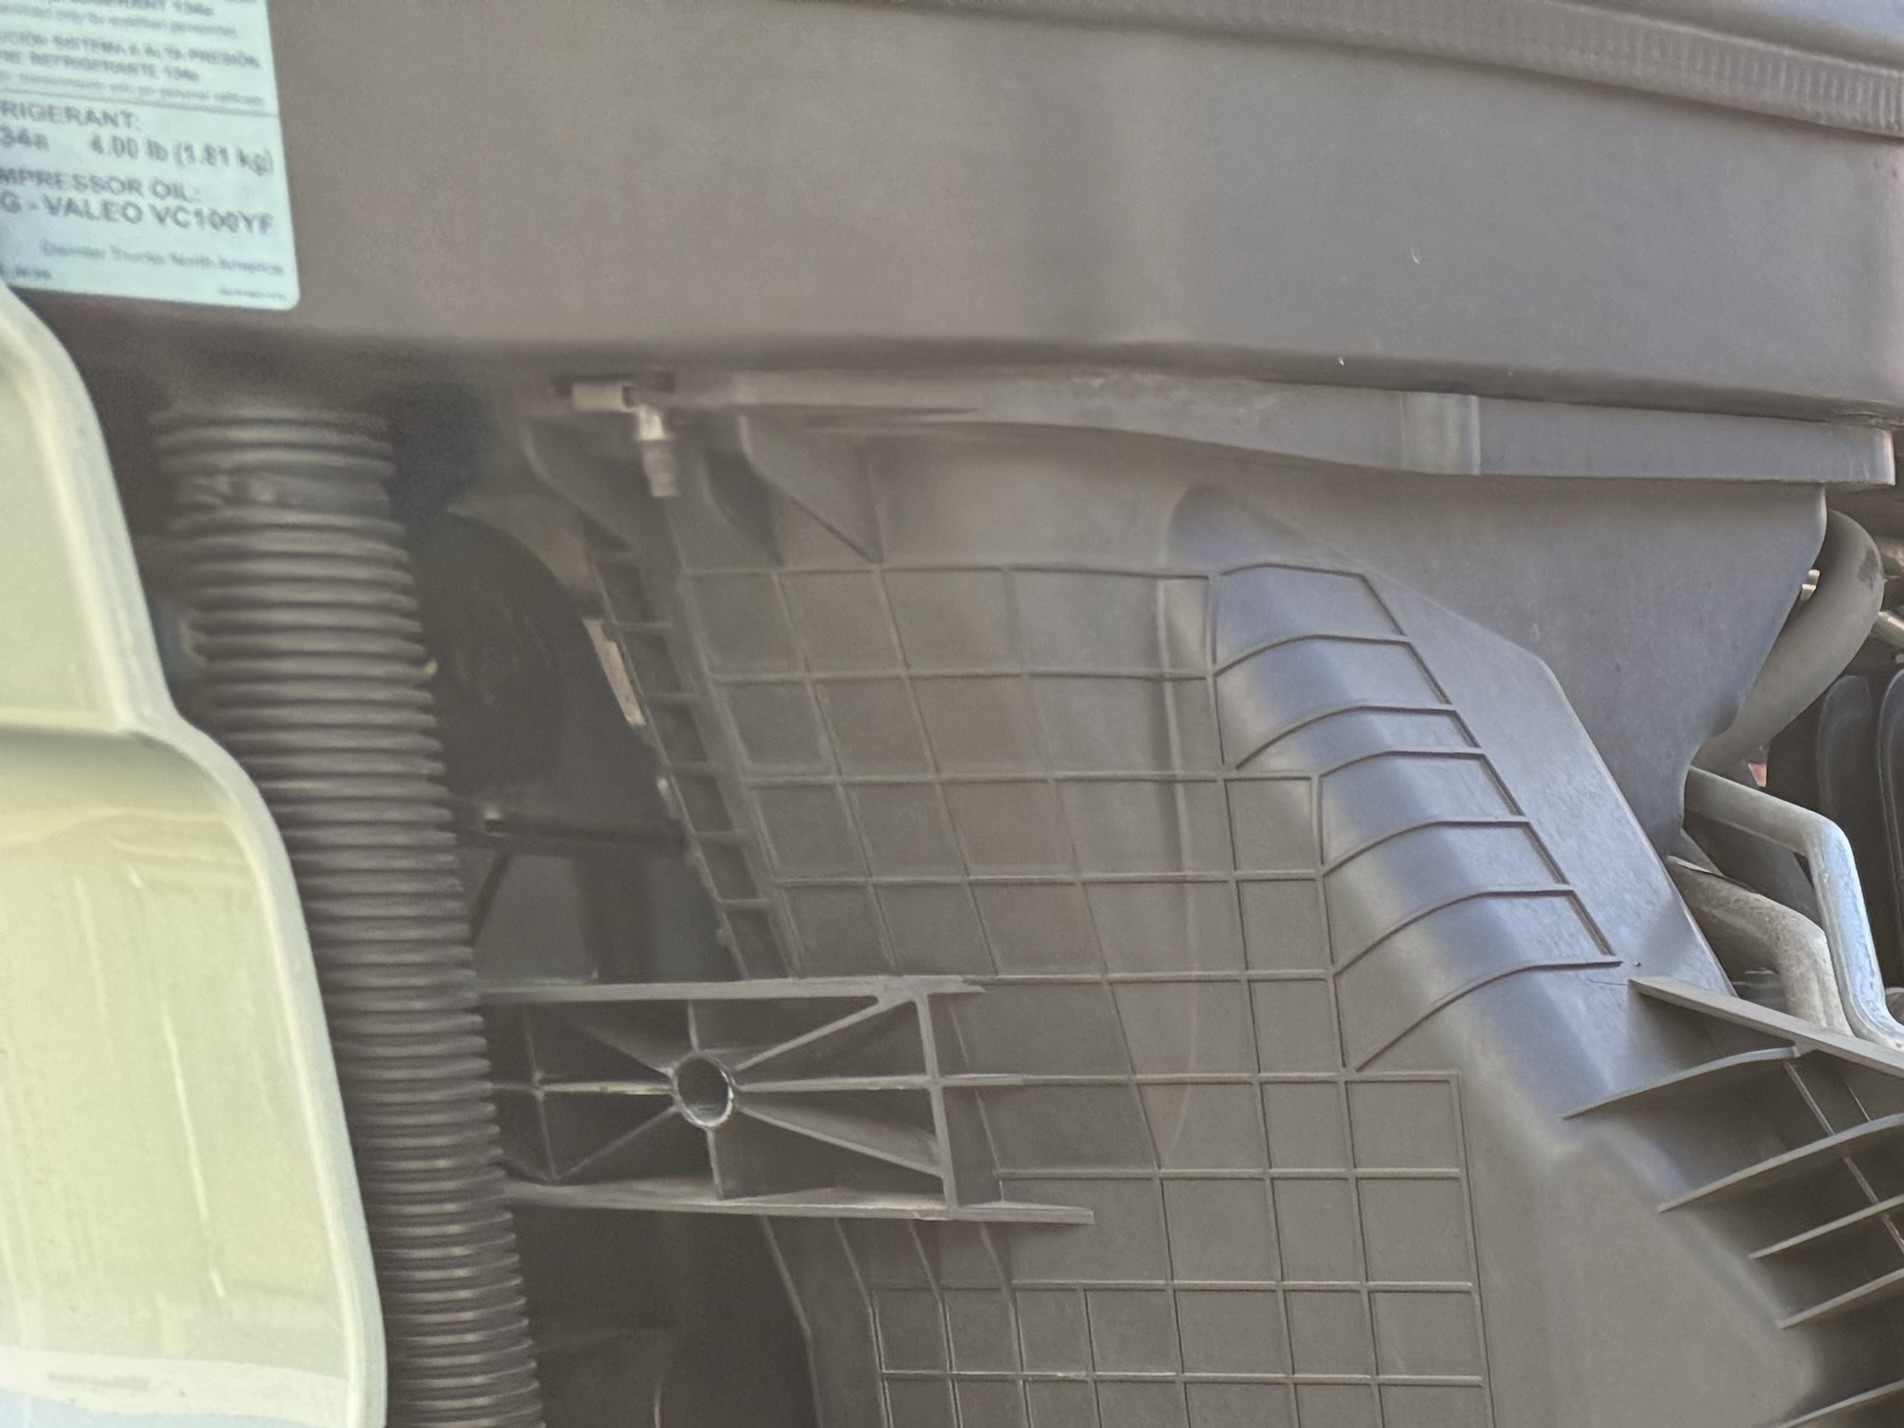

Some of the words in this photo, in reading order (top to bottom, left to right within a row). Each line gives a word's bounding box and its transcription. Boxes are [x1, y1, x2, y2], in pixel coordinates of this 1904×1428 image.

[0, 126, 48, 150] 34a
[0, 167, 144, 197] MPRESSOR
[42, 194, 144, 225] VALEO
[150, 203, 275, 235] VC100YF
